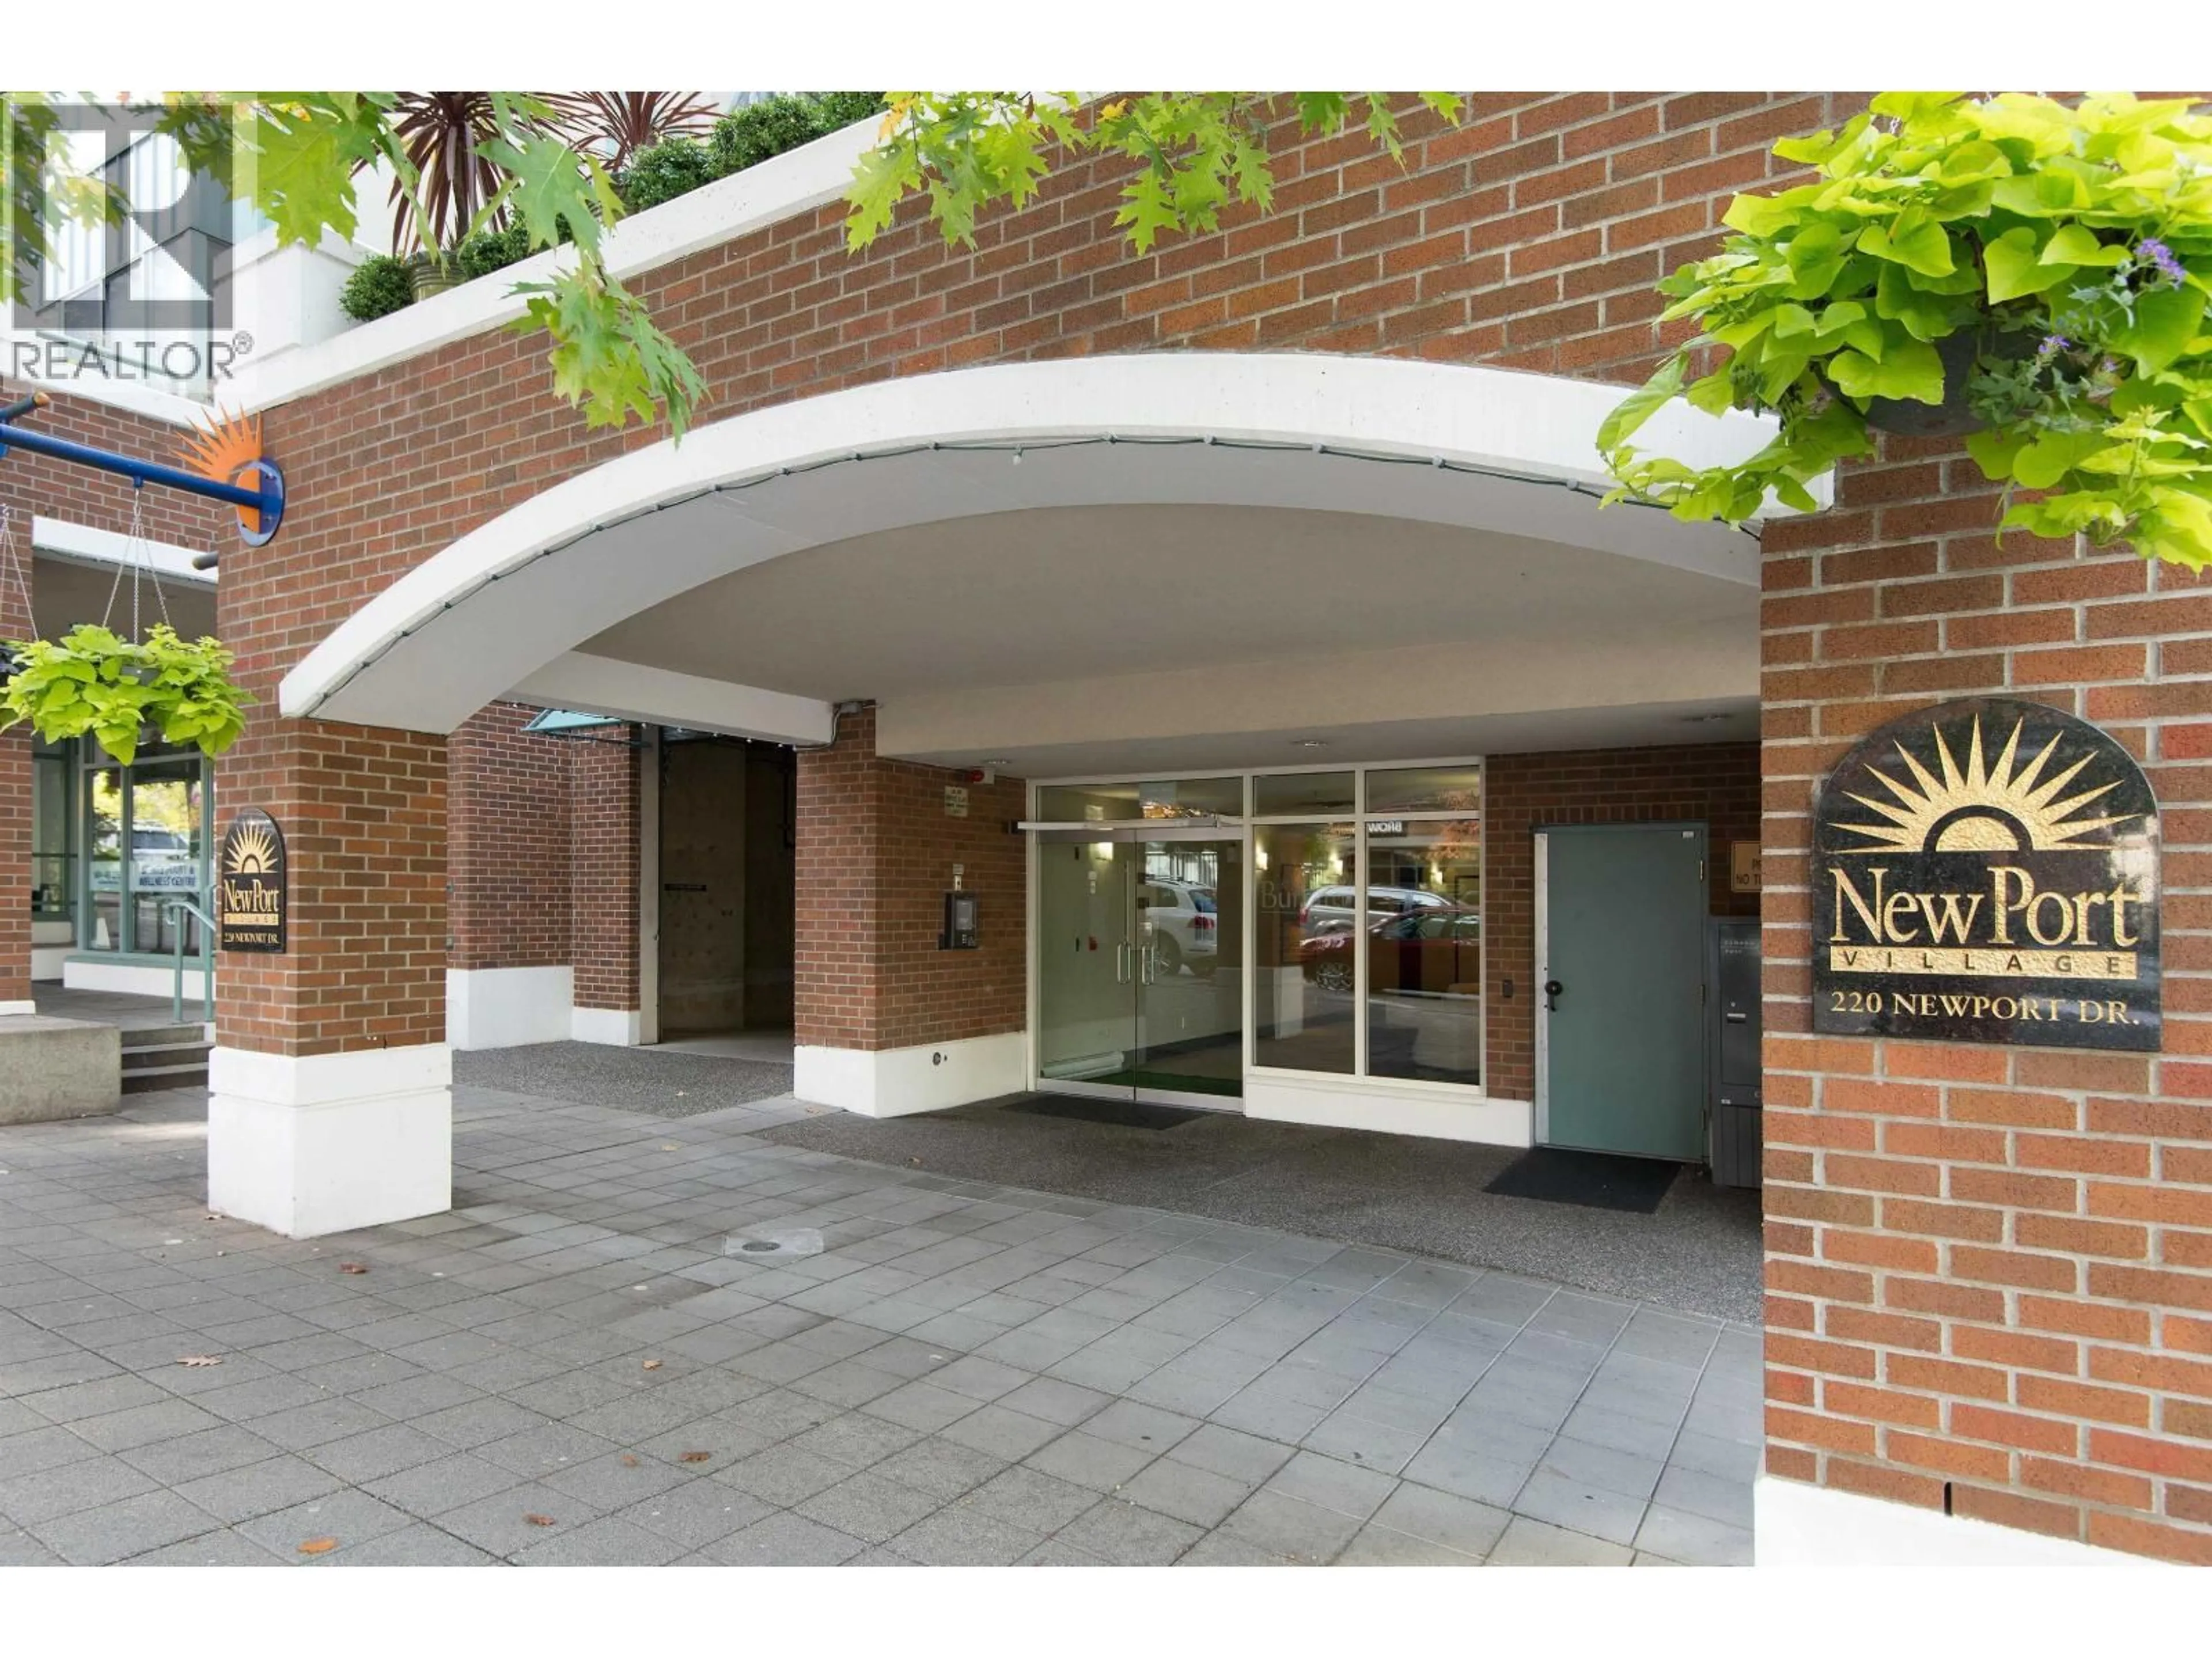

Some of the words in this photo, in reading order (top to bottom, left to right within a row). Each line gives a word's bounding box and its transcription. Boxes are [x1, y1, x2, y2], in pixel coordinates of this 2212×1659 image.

[1843, 950, 2120, 974] VILLAGE
[1831, 991, 1883, 1013] 220
[1892, 993, 2062, 1021] NEWPORT
[2078, 999, 2140, 1025] DR.
